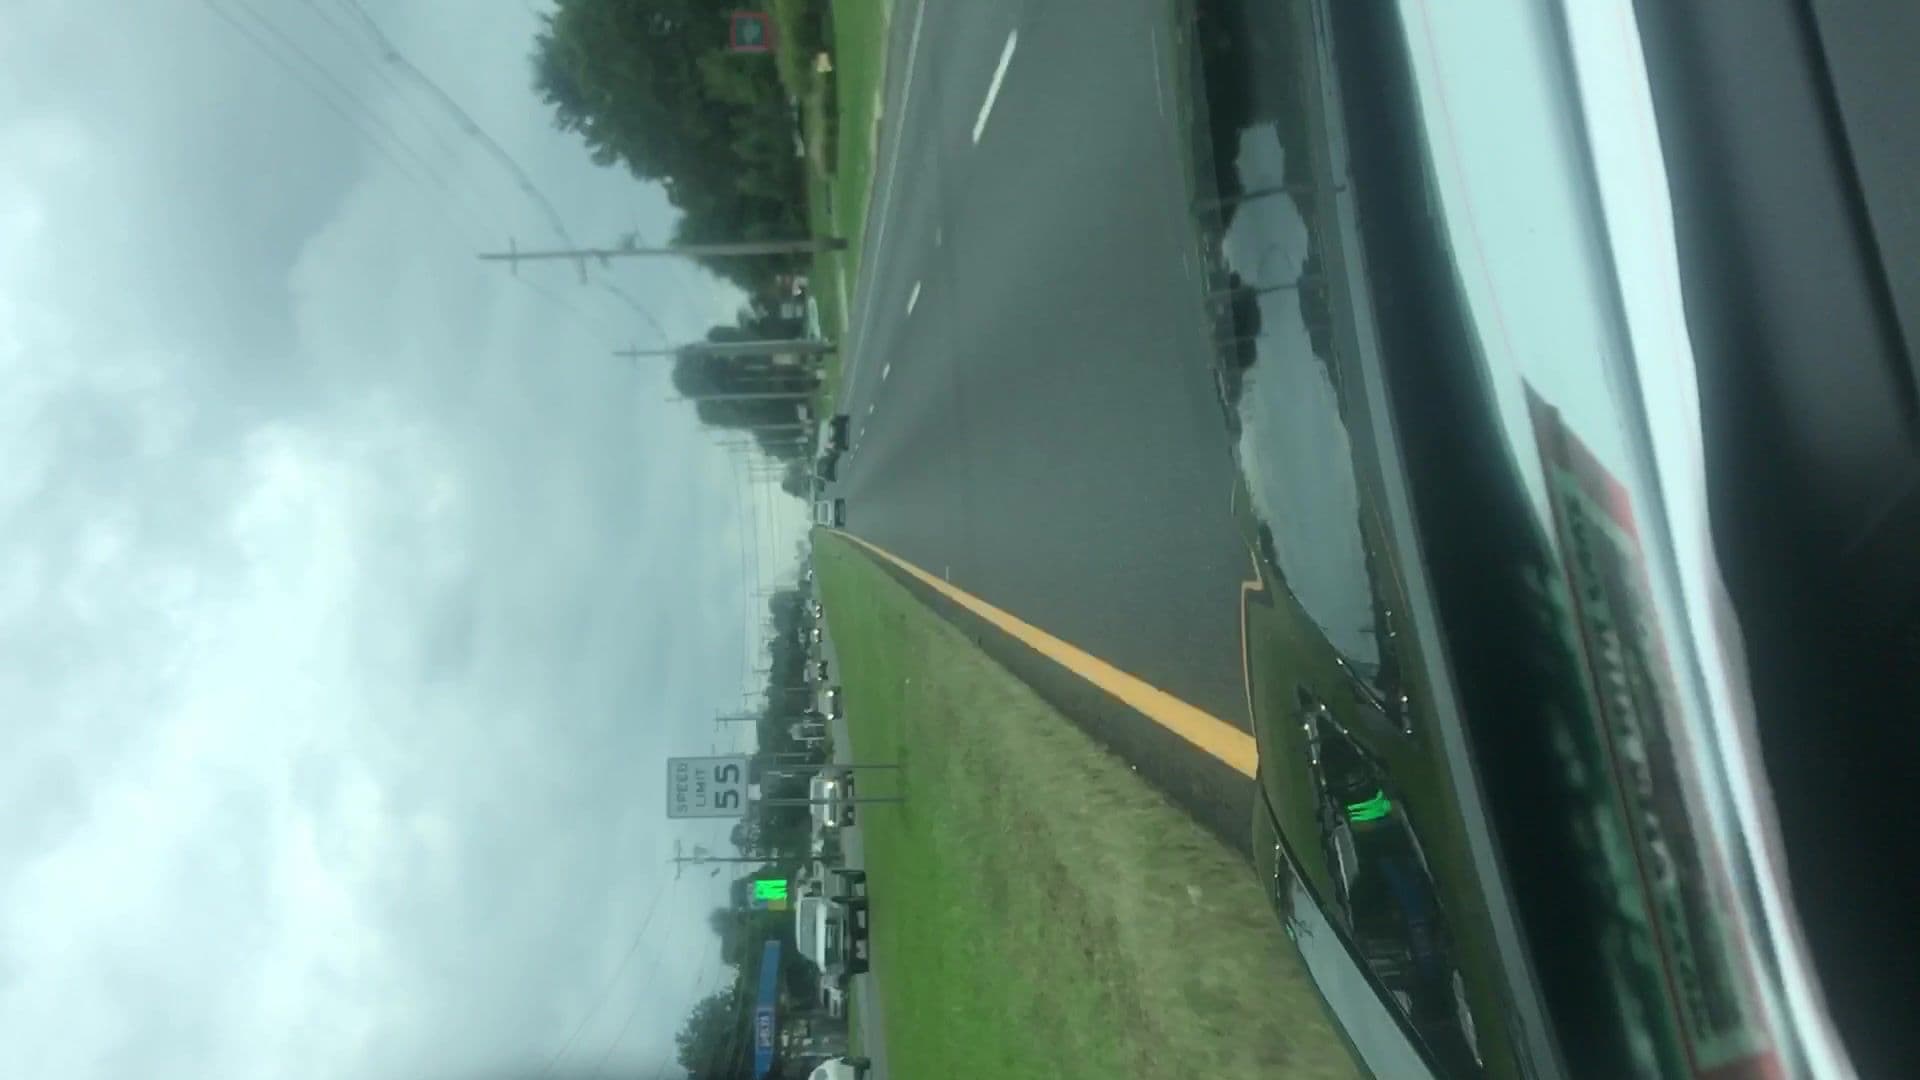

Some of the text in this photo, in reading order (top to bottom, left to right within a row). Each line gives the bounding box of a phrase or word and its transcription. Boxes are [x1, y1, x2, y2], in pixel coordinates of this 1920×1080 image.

[676, 762, 689, 813] SPEED
[695, 768, 705, 807] LIMIT
[714, 764, 739, 808] 55
